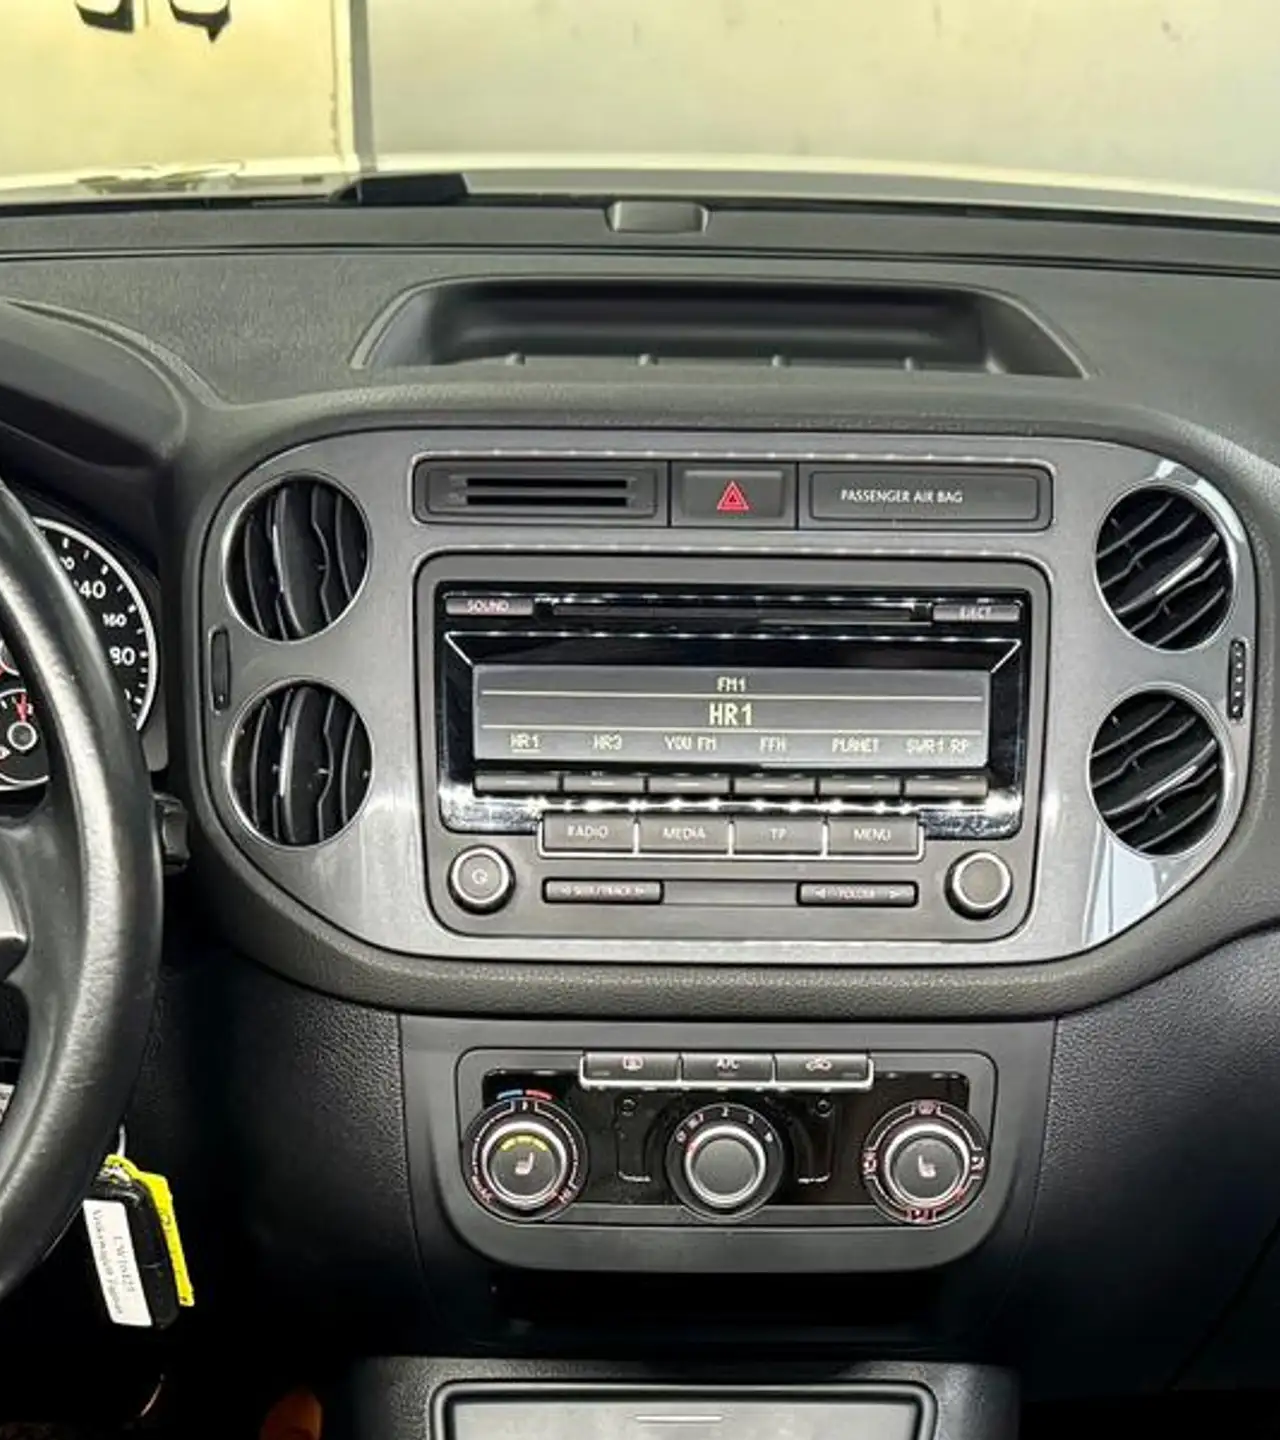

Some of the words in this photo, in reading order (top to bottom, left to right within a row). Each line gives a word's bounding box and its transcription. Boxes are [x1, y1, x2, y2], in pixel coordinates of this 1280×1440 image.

[840, 488, 911, 503] PASSENGER
[913, 489, 934, 503] AIR
[937, 490, 964, 504] BAG
[467, 600, 510, 613] SOUND
[102, 612, 128, 628] 160
[716, 676, 747, 693] FM1
[708, 703, 753, 726] HR1
[509, 733, 542, 749] HR1
[592, 733, 624, 750] HR3
[664, 735, 694, 752] YOU
[759, 737, 788, 753] FFH
[831, 737, 881, 754] PLANET
[567, 824, 610, 839] RADIO
[662, 826, 707, 841] MEDIA
[769, 827, 788, 842] TP
[852, 828, 893, 843] MENU
